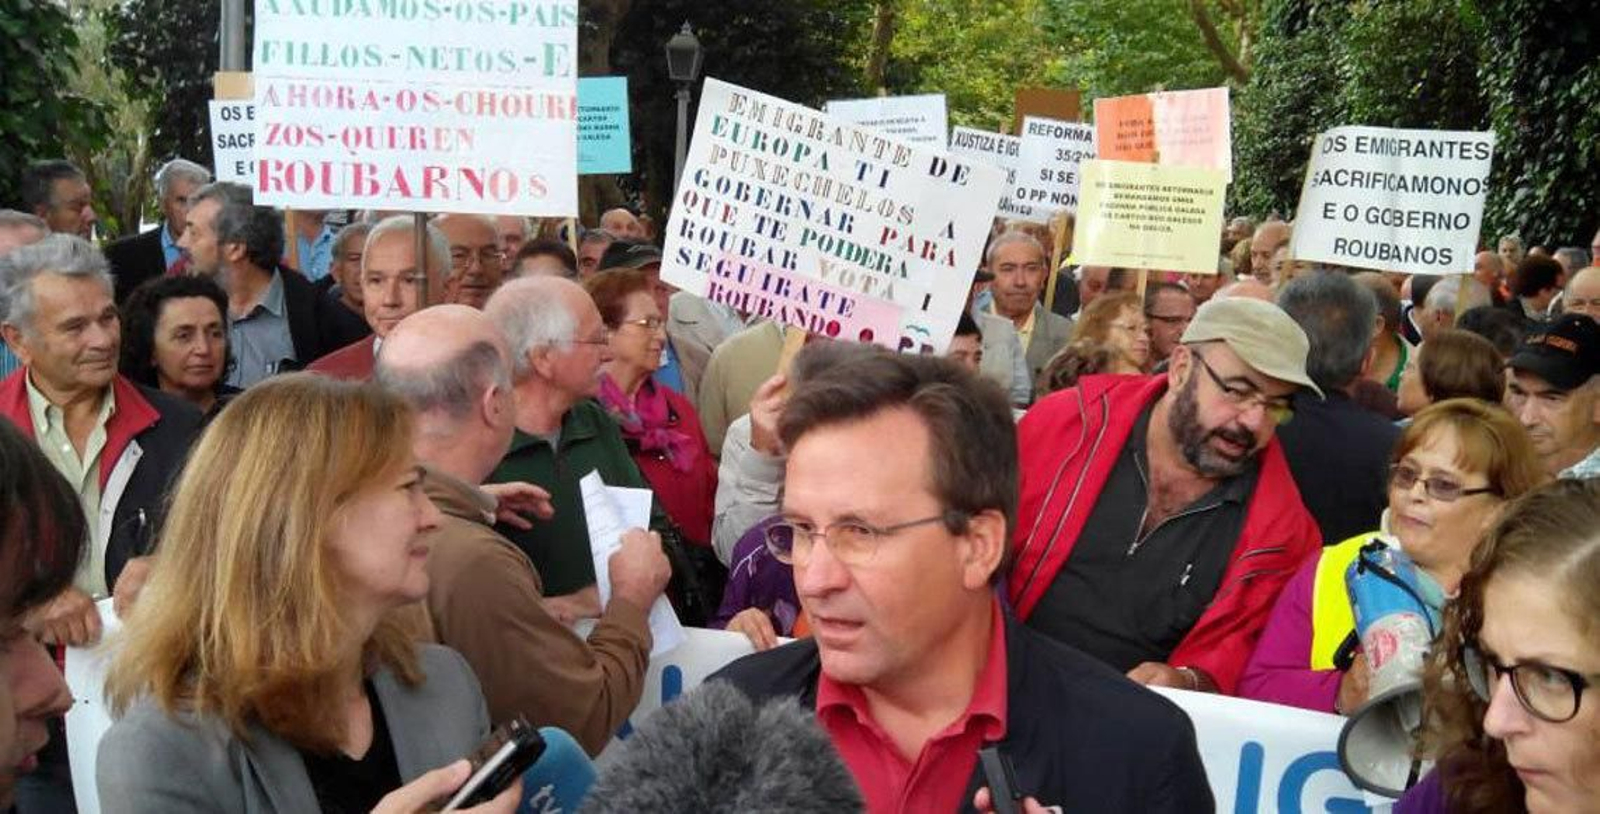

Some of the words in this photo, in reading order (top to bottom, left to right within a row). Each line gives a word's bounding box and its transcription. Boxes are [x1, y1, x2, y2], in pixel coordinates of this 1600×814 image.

[221, 106, 242, 121] OS
[728, 92, 912, 168] EMIGRANTE
[928, 156, 971, 186] DE
[1027, 121, 1093, 144] REFORMA
[711, 114, 830, 171] EUROPA
[855, 159, 891, 189] TI
[1322, 135, 1347, 155] OS
[1354, 136, 1490, 161] EMIGRANTES
[1016, 187, 1026, 200] O
[1030, 189, 1048, 202] PP
[682, 189, 738, 227] QUE
[754, 212, 788, 243] TE
[694, 168, 854, 235] GOBERNAR
[879, 226, 957, 267] PARA
[939, 221, 956, 240] A
[1322, 203, 1337, 220] E
[1343, 204, 1359, 222] O
[1366, 206, 1471, 231] GOBERNO
[679, 218, 798, 271] ROUBAR
[816, 258, 895, 300] VOTA
[1334, 237, 1453, 266] ROUBANOS
[708, 281, 841, 337] ROUBANDO
